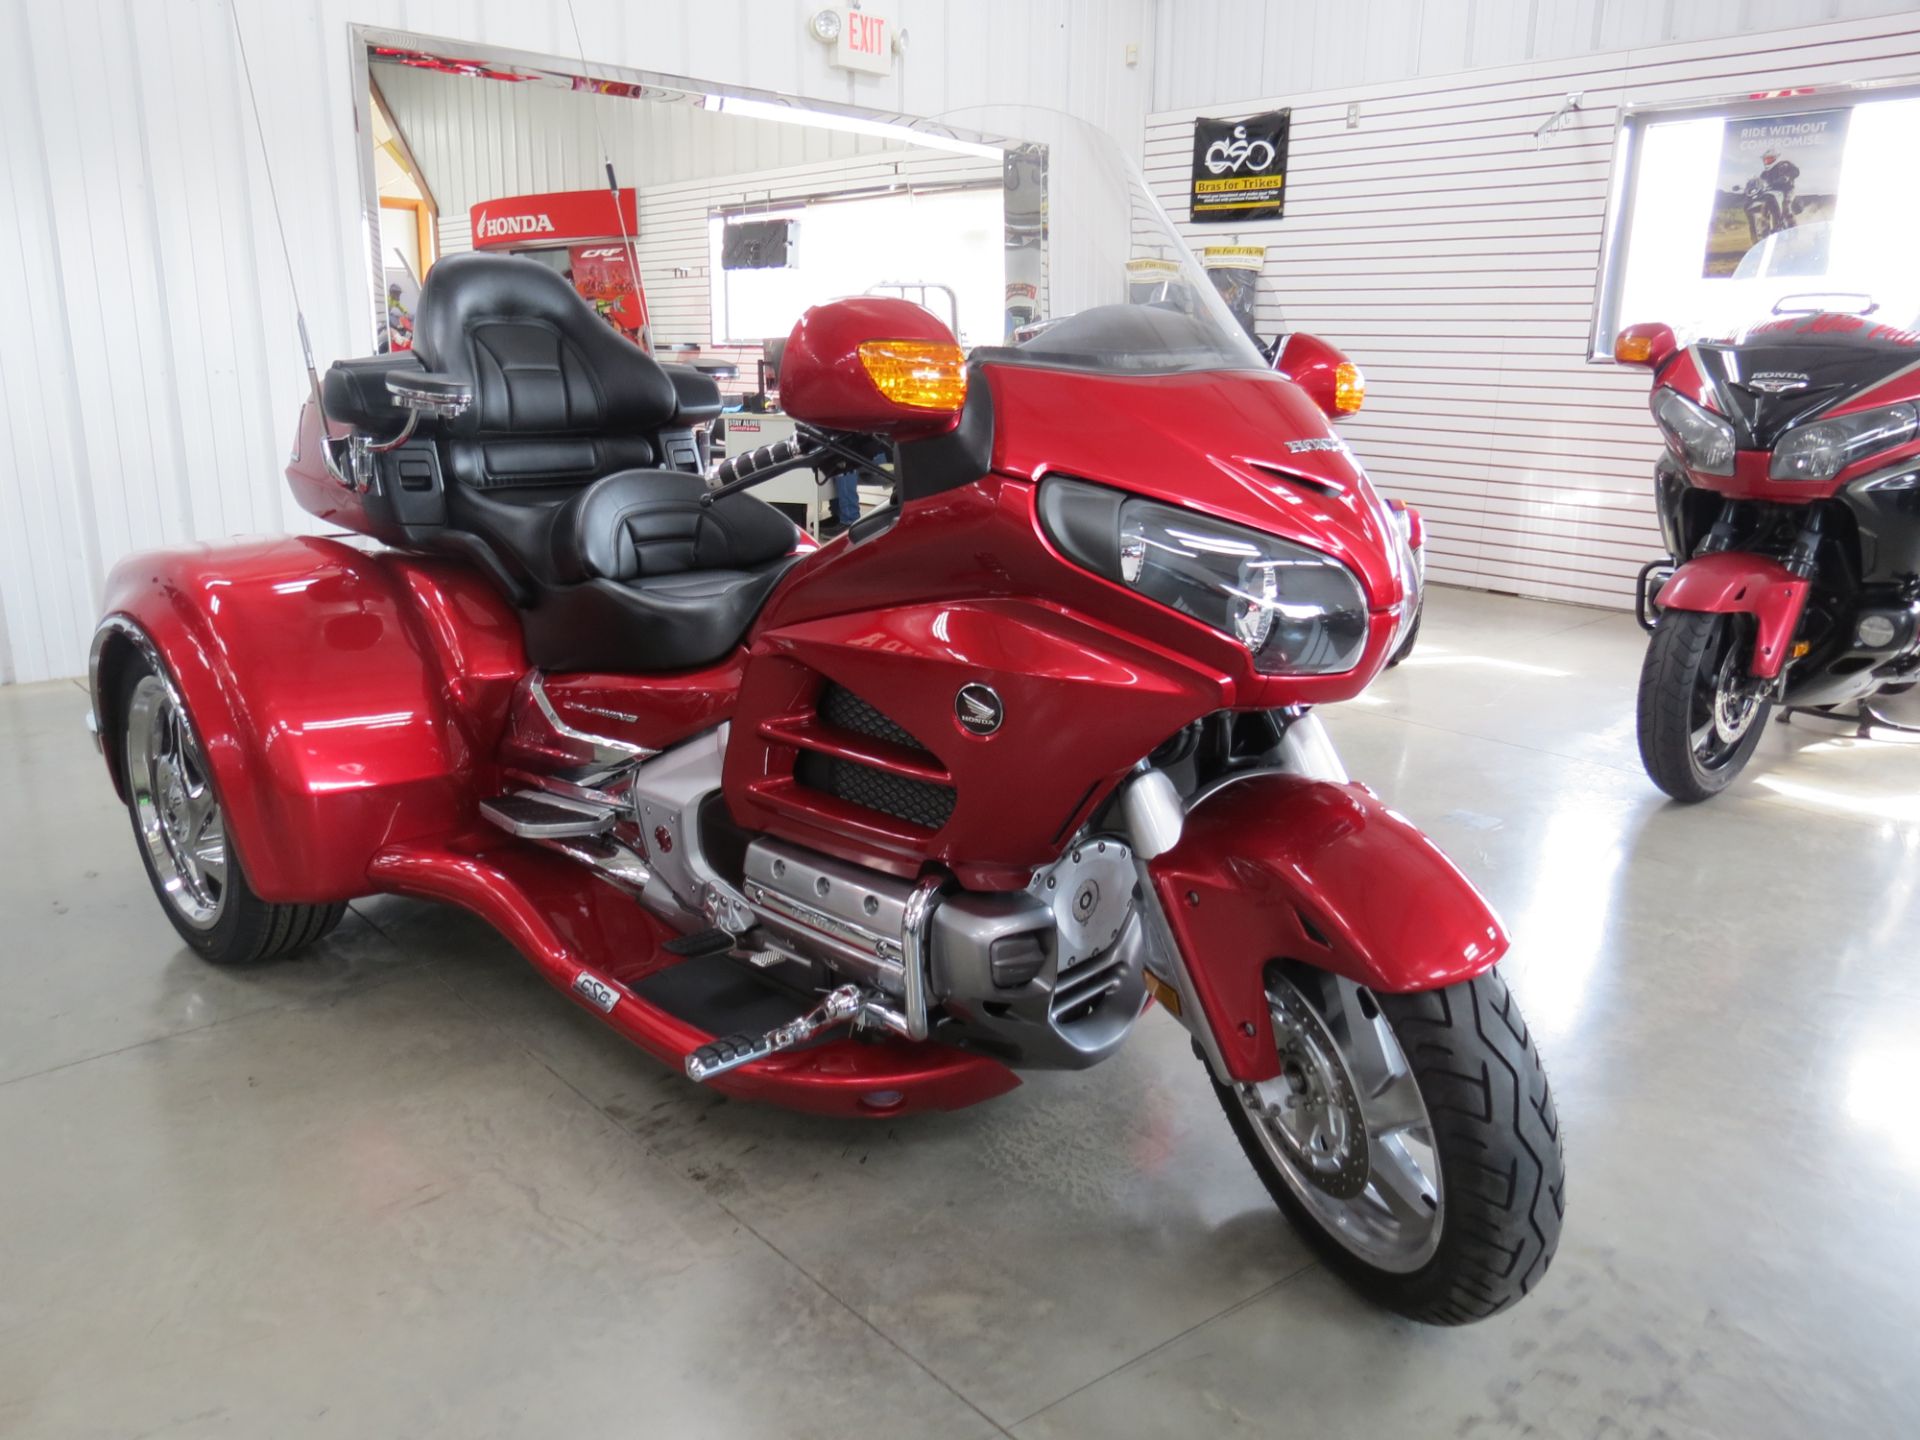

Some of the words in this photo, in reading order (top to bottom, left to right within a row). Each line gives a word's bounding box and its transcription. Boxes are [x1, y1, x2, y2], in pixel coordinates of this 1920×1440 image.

[848, 12, 885, 56] EXIT
[1740, 126, 1767, 139] RIDE
[1769, 121, 1828, 137] WITHOUT
[1198, 182, 1221, 192] Bras
[1223, 180, 1240, 190] for
[1242, 177, 1279, 189] Trikes
[486, 214, 555, 237] HONDA
[580, 247, 624, 259] CRF
[1751, 372, 1810, 381] HONDA
[961, 715, 995, 726] HONDA
